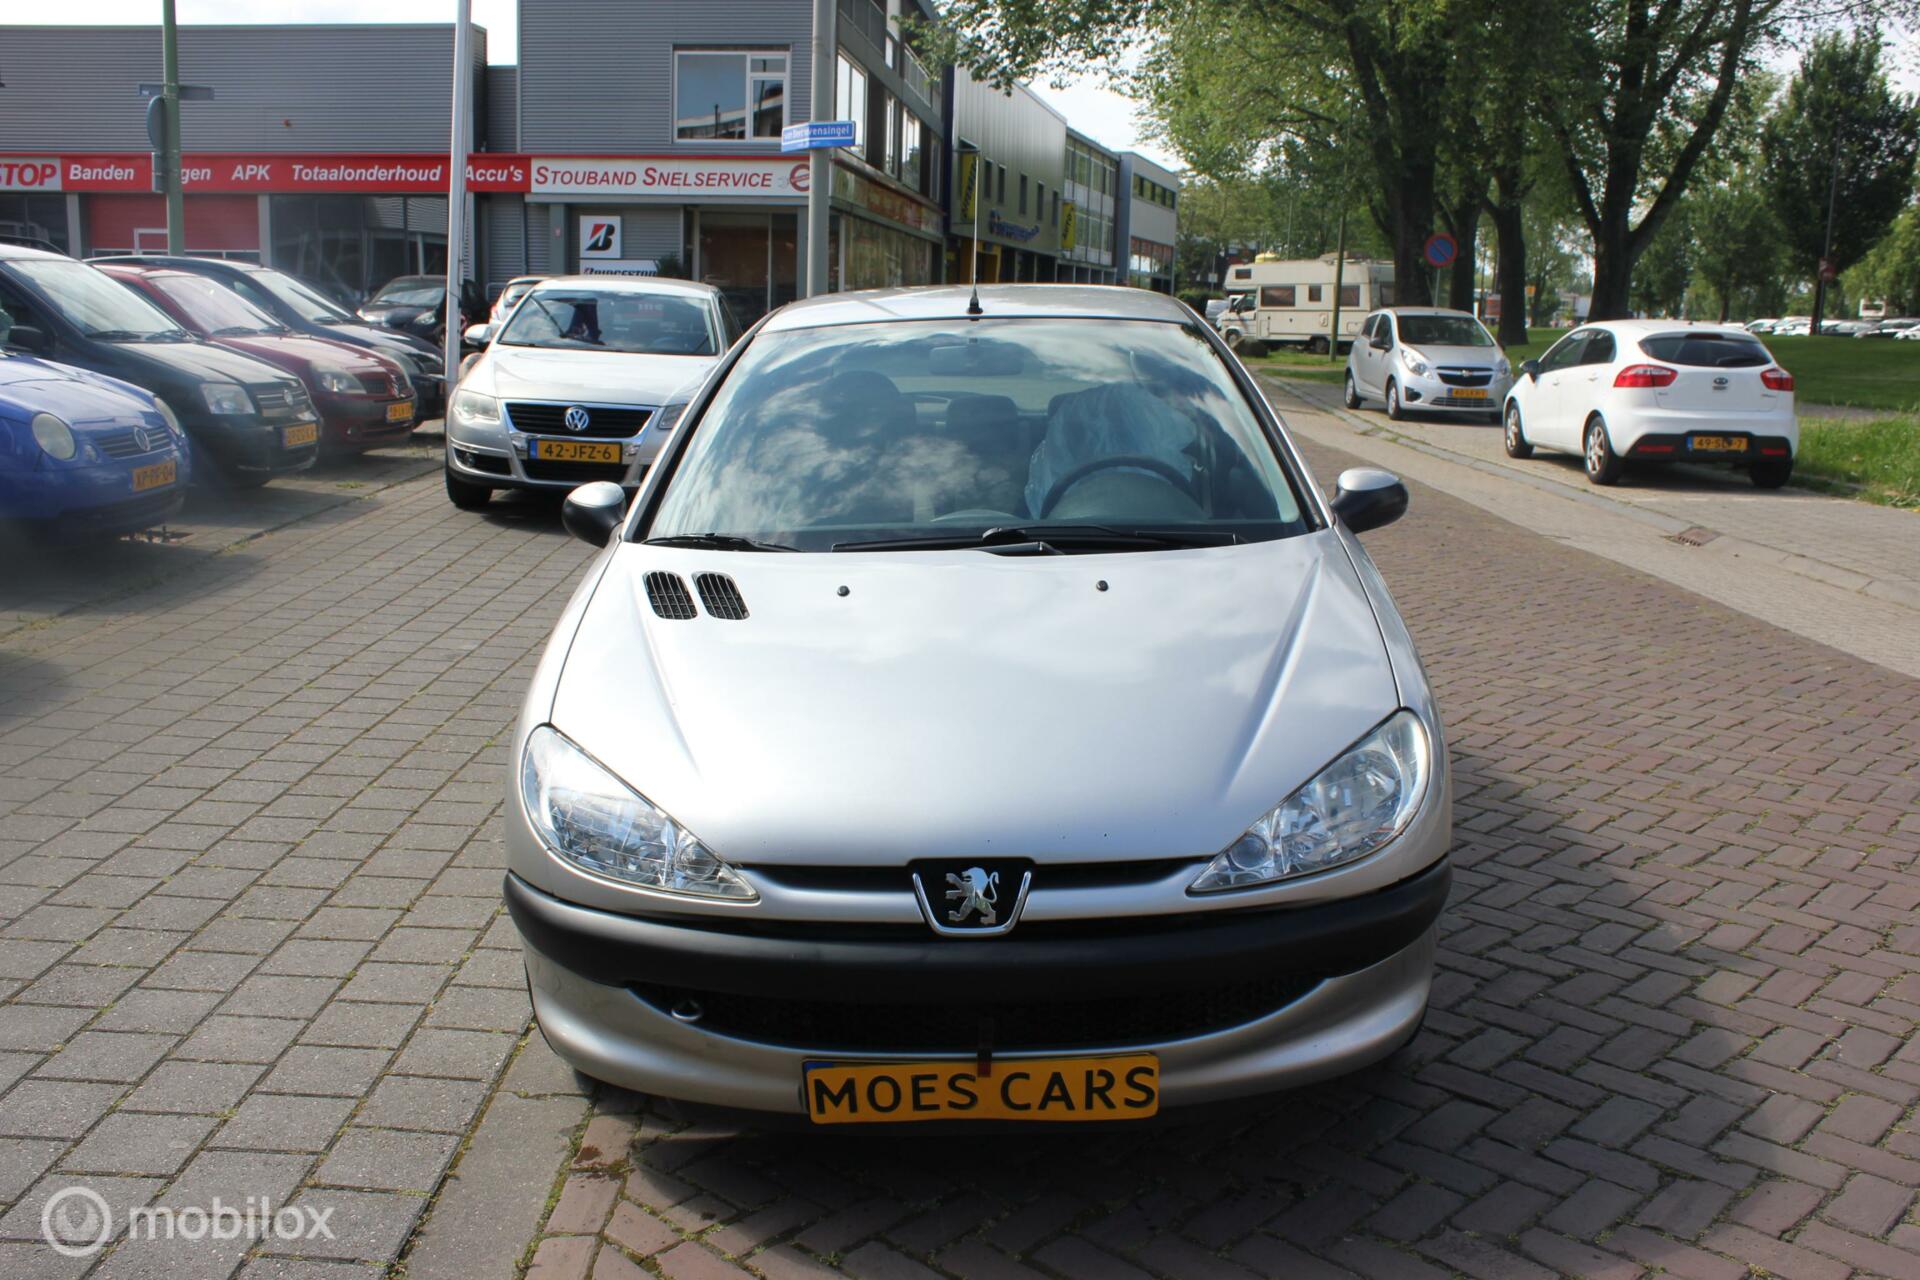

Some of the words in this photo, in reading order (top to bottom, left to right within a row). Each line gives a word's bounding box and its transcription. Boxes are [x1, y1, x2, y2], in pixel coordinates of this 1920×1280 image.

[0, 163, 57, 187] TOP
[69, 164, 135, 181] Banden
[231, 164, 272, 181] APK
[292, 165, 442, 182] Totaalonderhoud
[465, 165, 523, 182] Accu's
[535, 166, 636, 187] STOUBAND
[642, 167, 773, 188] SNELSERVICE
[544, 443, 612, 460] 42-JFZ-6
[813, 1073, 979, 1115] MOES
[1000, 1066, 1156, 1111] CARS
